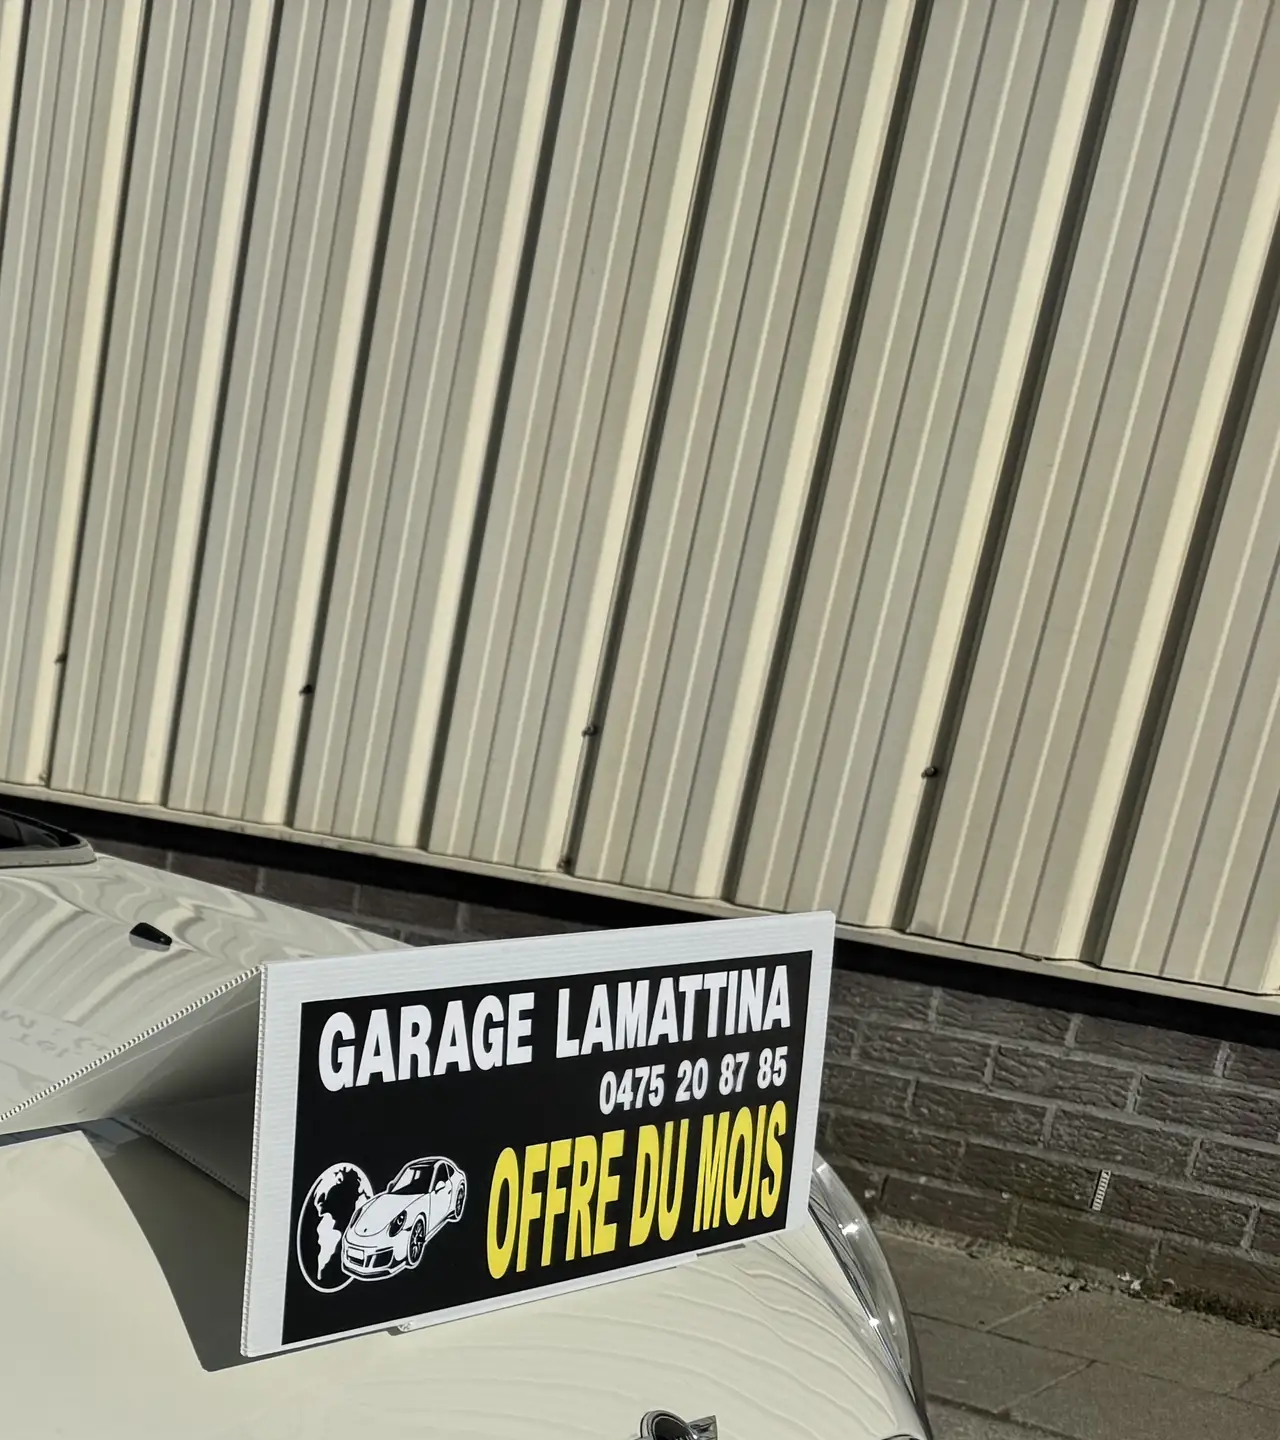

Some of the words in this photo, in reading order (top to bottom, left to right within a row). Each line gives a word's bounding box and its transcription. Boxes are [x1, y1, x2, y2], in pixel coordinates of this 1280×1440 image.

[318, 991, 535, 1091] GARAGE
[555, 965, 791, 1058] LAMATTINA
[600, 1070, 664, 1115] 0475
[676, 1060, 708, 1103] 20
[719, 1053, 748, 1096] 87
[757, 1046, 788, 1089] 85
[486, 1130, 624, 1279] OFFRE
[629, 1119, 689, 1246] DU
[692, 1101, 787, 1232] MOIS
